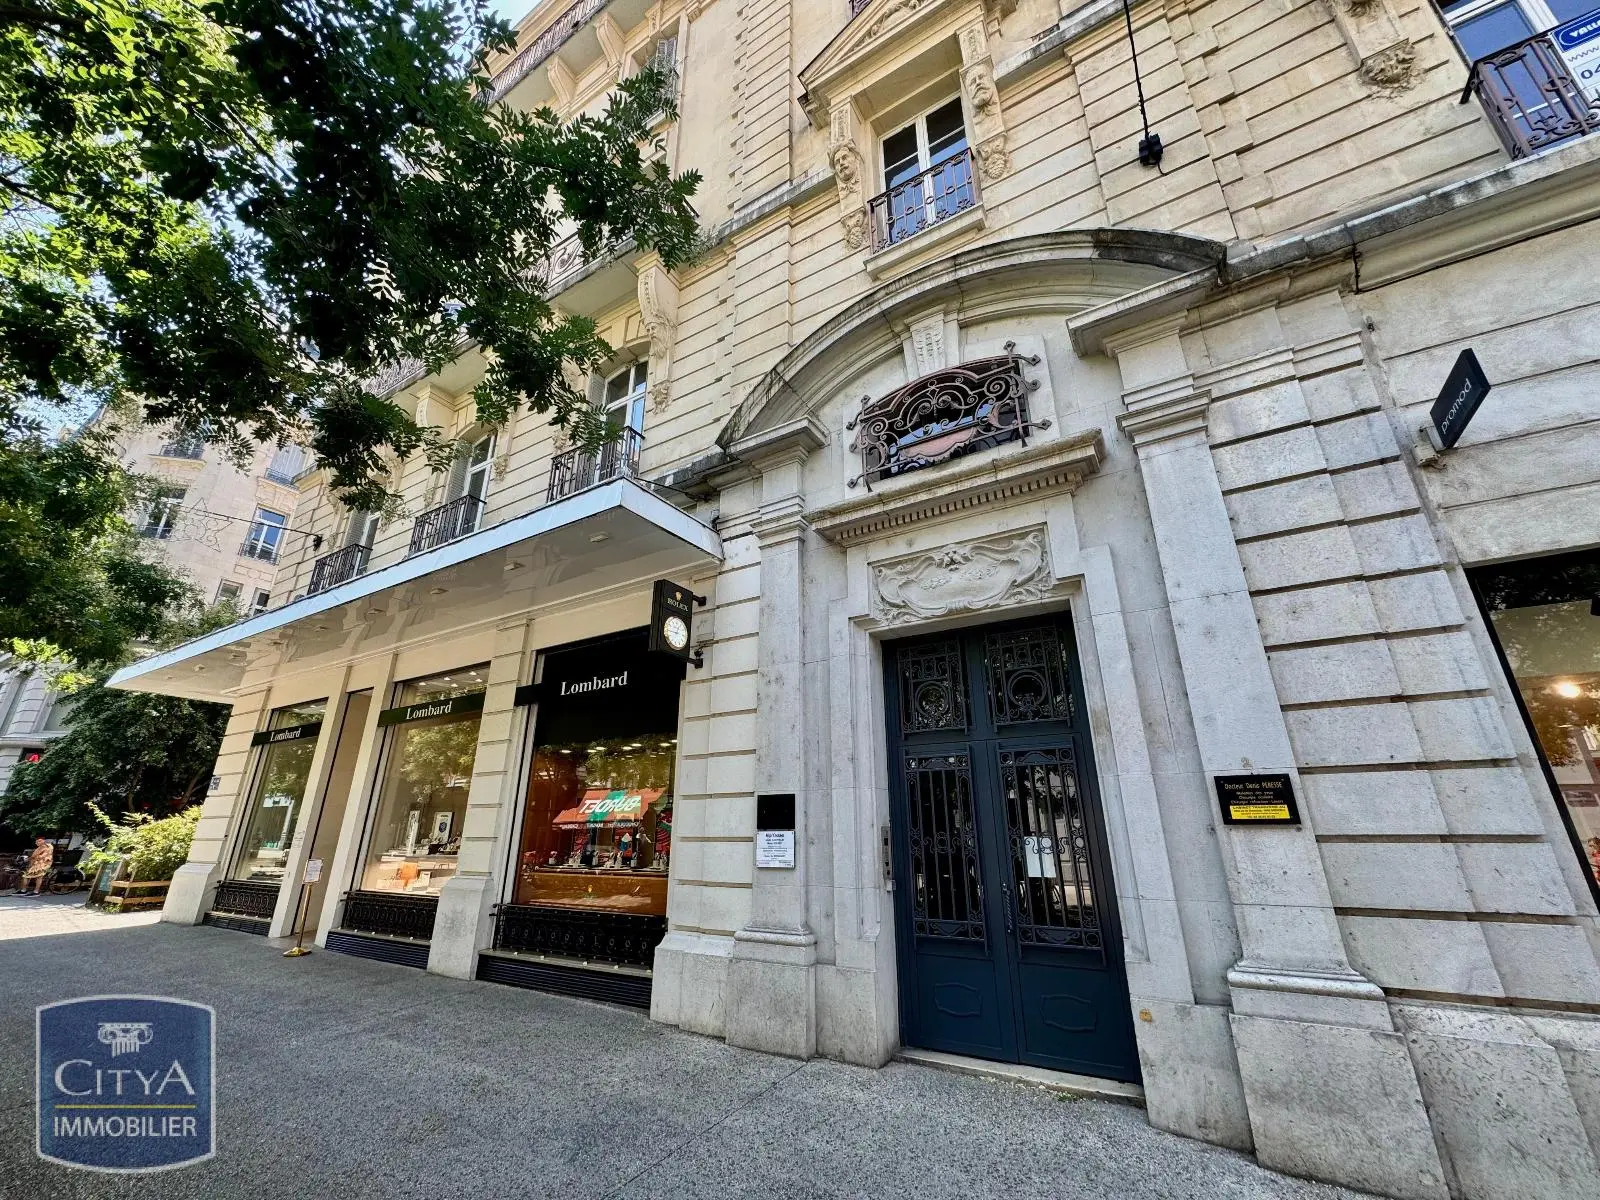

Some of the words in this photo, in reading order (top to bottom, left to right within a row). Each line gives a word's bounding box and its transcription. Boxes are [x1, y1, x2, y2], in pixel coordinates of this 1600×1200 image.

[1441, 378, 1472, 434] promod
[667, 597, 689, 612] ROLEX
[560, 670, 628, 696] Lombard
[406, 700, 453, 720] Lombard
[270, 727, 302, 742] Lombard
